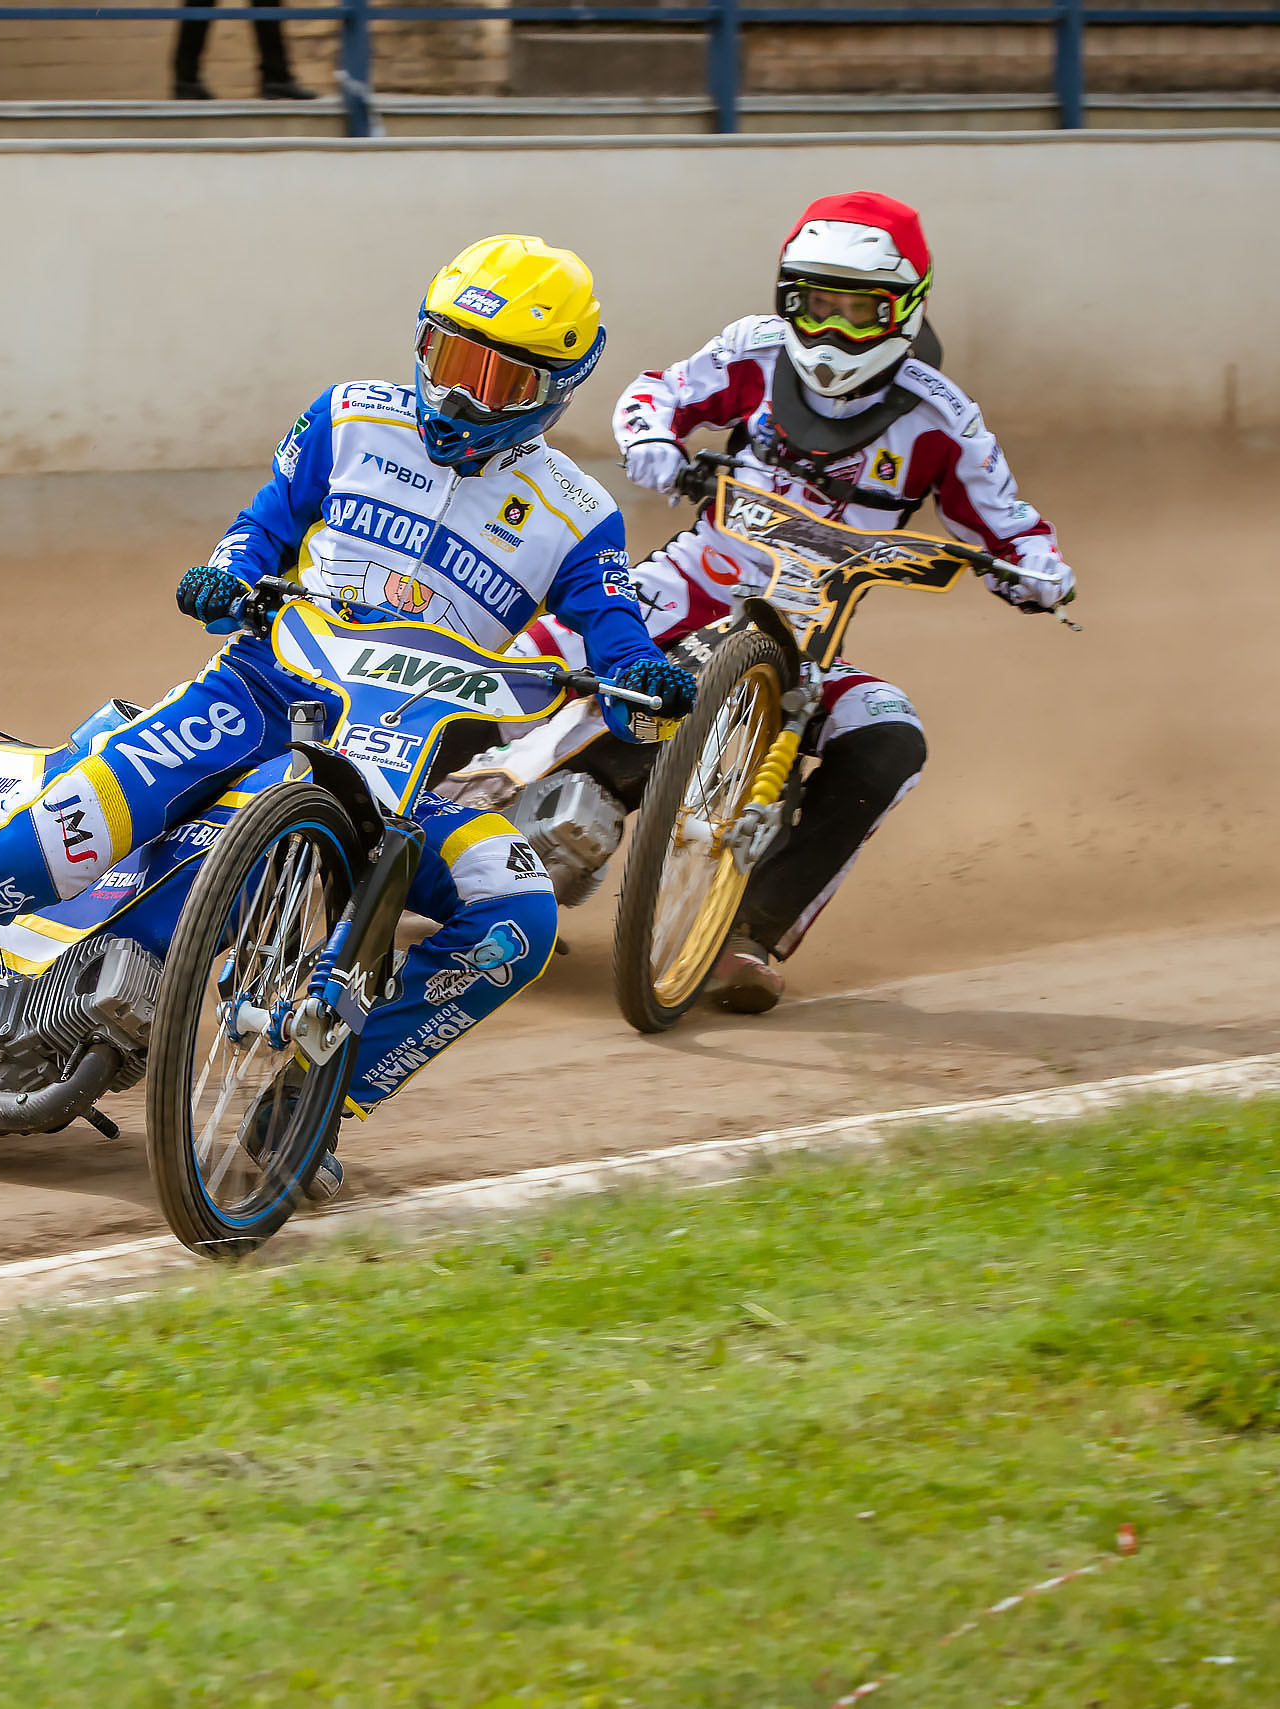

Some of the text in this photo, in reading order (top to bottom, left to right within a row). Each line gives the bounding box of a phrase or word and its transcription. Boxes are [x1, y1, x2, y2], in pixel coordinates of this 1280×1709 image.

[342, 383, 416, 407] FST
[351, 401, 375, 410] Grupa
[384, 461, 433, 493] PBDI
[545, 457, 599, 510] NICOLAUS
[115, 701, 246, 787] Nice
[342, 727, 422, 760] FST
[348, 750, 409, 770] Grupa Brokerska
[43, 794, 98, 865] JMS
[515, 872, 537, 880] AUTO
[361, 1002, 460, 1084] ROBERT SKRZYPEK
[371, 1010, 478, 1093] ROB-MAN
